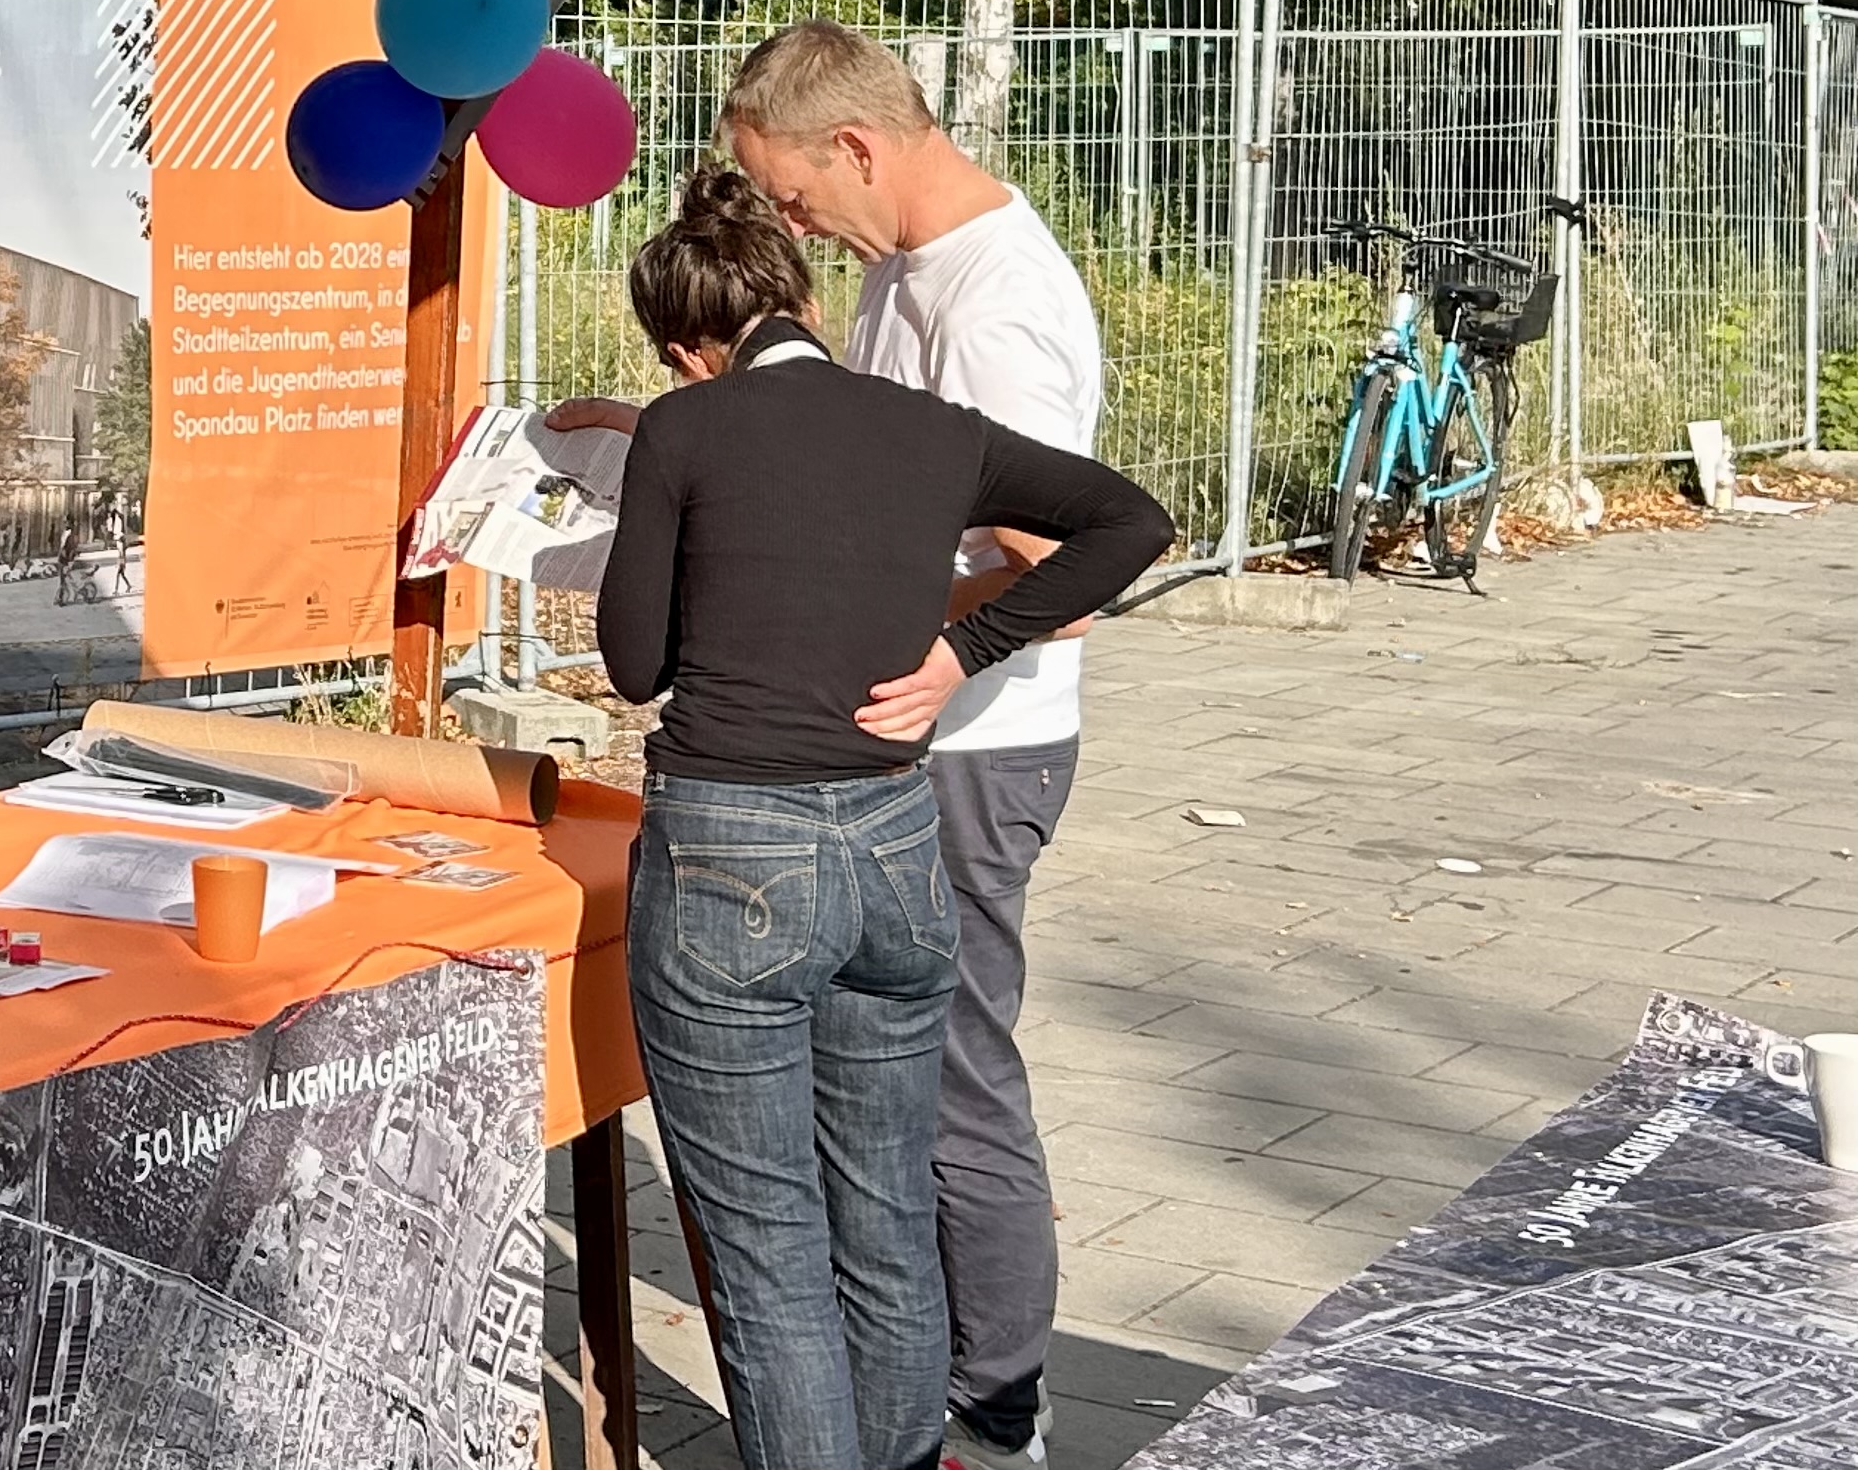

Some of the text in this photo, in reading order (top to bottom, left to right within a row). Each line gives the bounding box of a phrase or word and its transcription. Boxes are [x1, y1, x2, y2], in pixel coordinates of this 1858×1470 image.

[173, 244, 212, 271] Hier
[217, 242, 291, 270] entsteht
[295, 242, 324, 270] ab
[329, 242, 383, 269] 2028
[173, 284, 374, 318] Begegnungszentrum,
[377, 284, 394, 307] in
[172, 325, 336, 355] Stadtteilzentrum,
[339, 325, 366, 348] ein
[173, 367, 208, 395] und
[212, 365, 243, 393] die
[172, 407, 259, 443] Spandau
[265, 405, 312, 433] Platz
[316, 402, 369, 430] finden
[133, 1016, 496, 1183] 50 JAH ALKENHAGENER FELD
